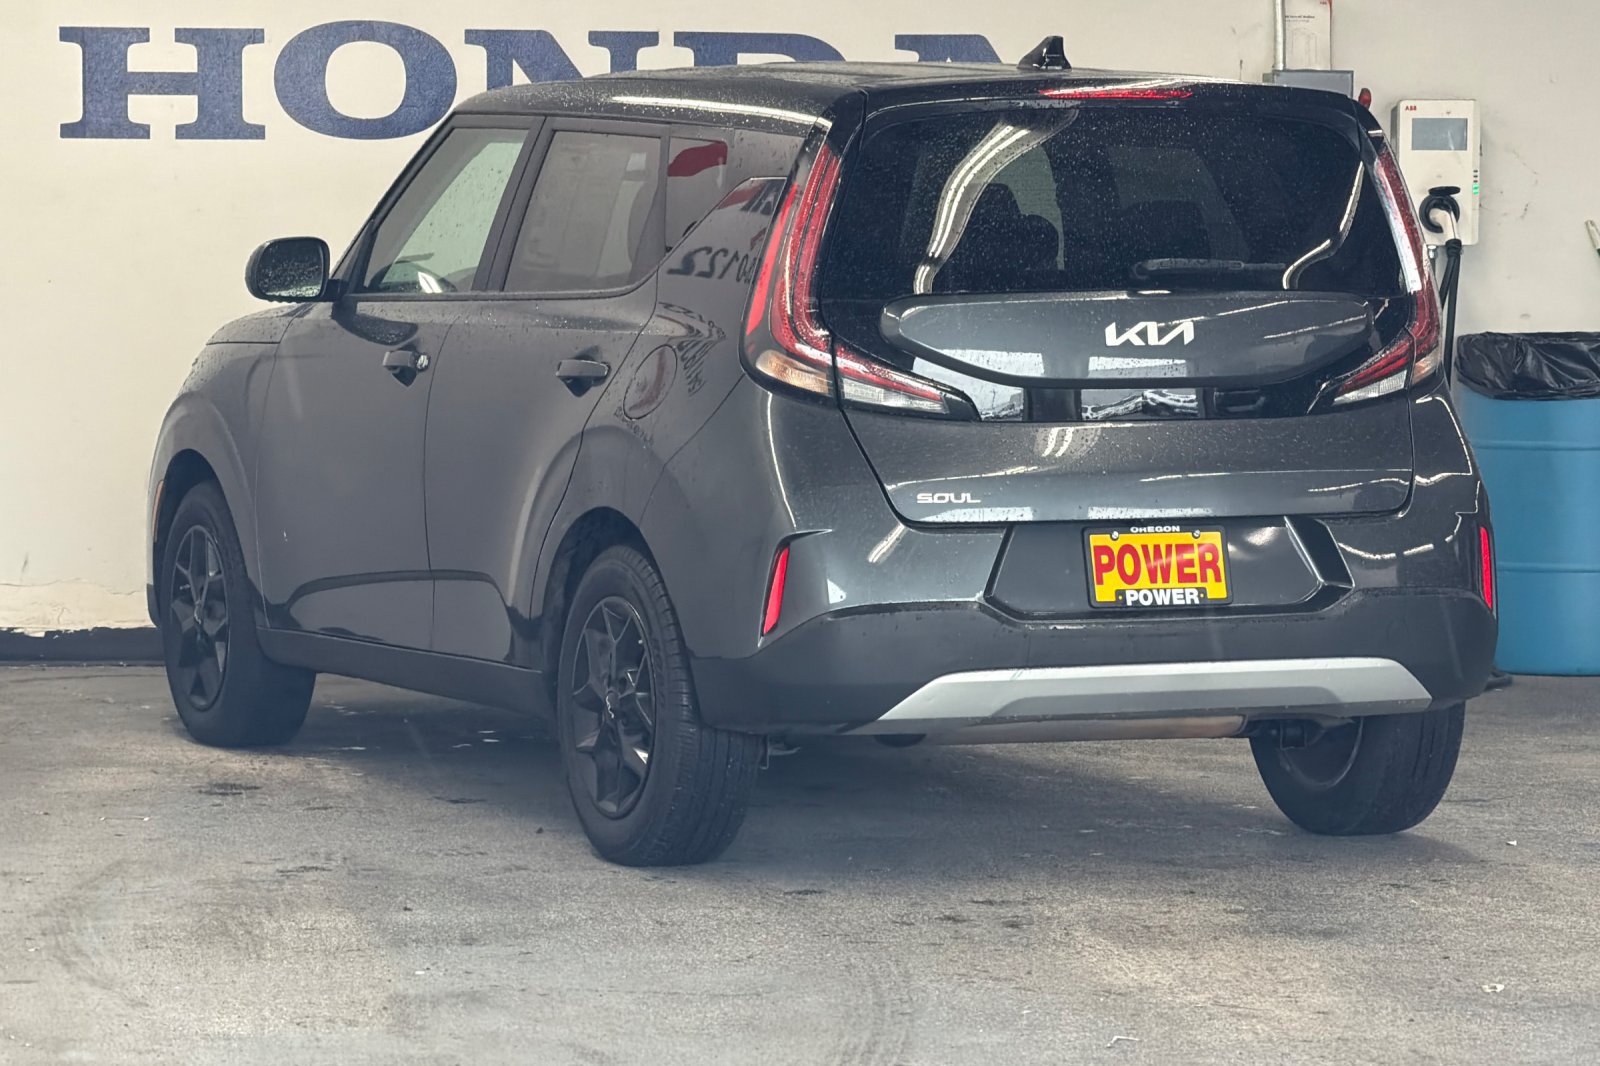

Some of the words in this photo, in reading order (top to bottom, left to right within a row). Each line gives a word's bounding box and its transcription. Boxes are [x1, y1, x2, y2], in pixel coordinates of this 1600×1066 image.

[58, 19, 1004, 140] HON
[1104, 321, 1194, 346] KIA
[916, 492, 981, 504] SOUL
[1130, 525, 1180, 534] OREGON
[1093, 543, 1222, 586] POWER
[1125, 588, 1200, 606] POWER
